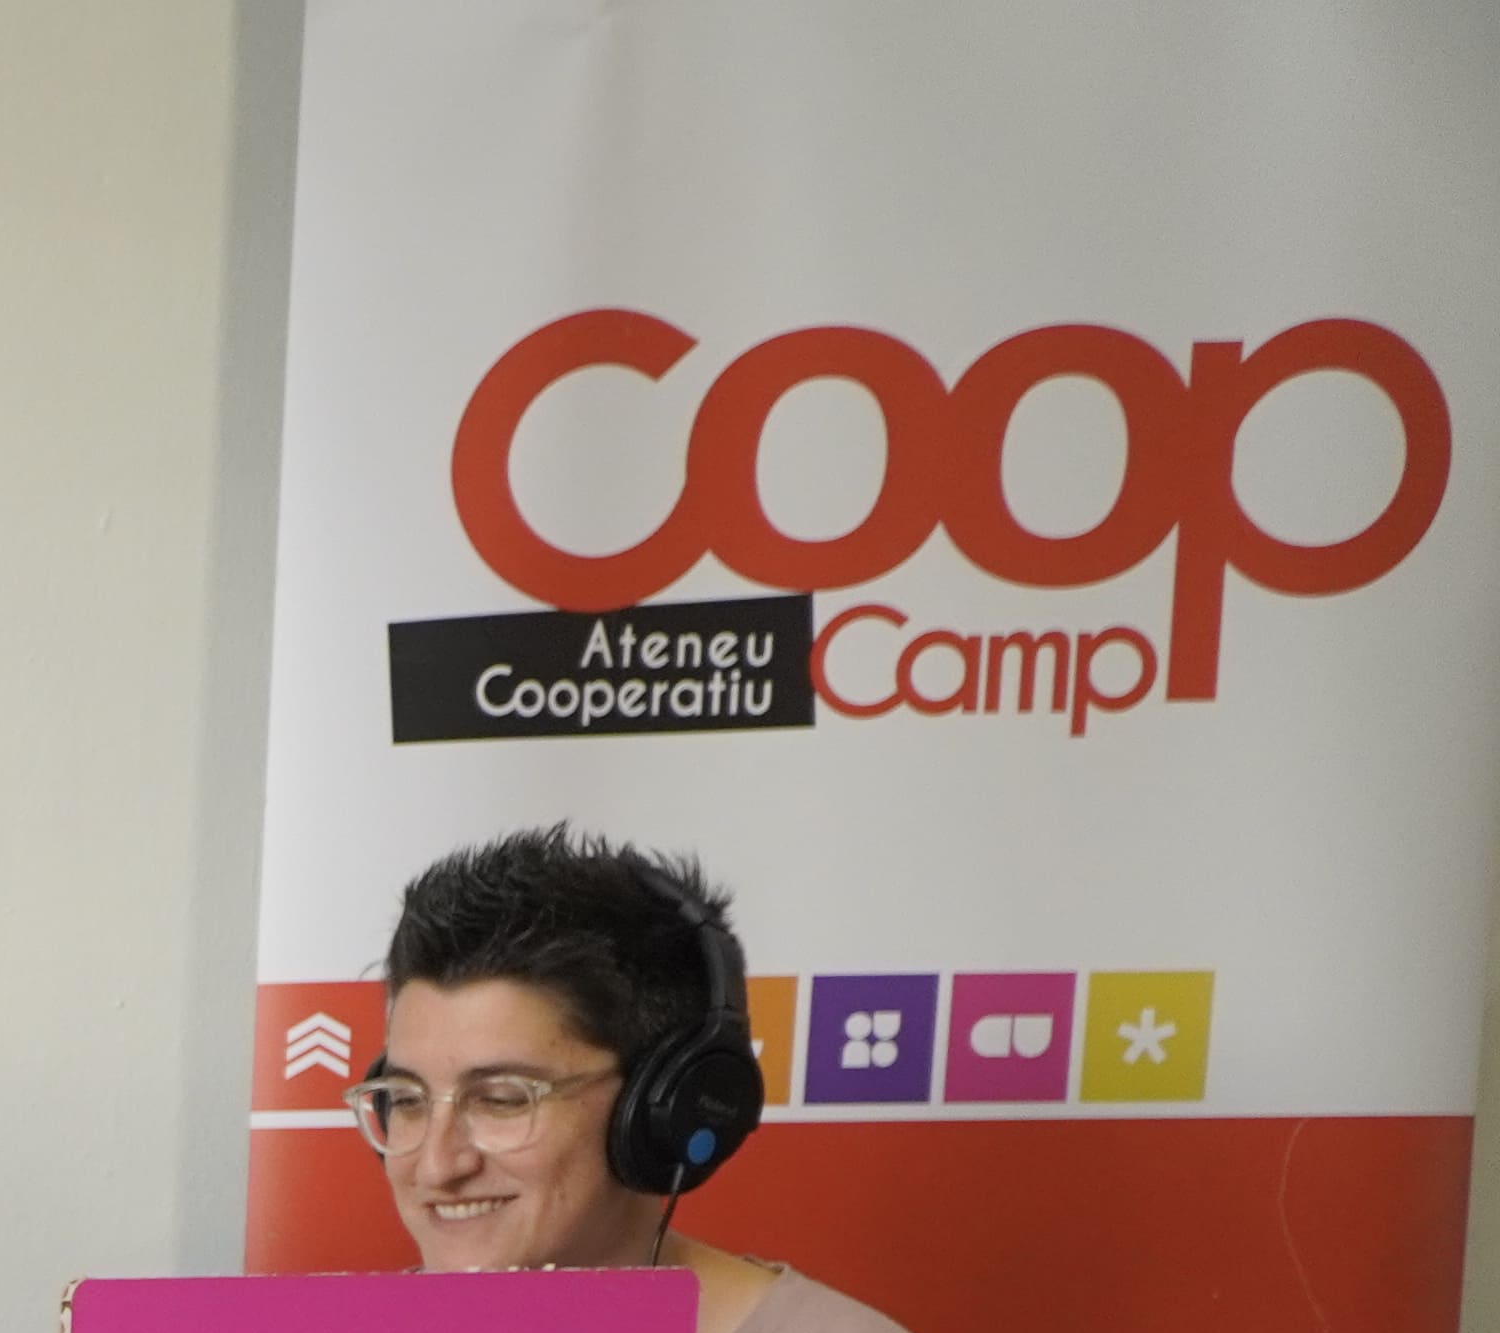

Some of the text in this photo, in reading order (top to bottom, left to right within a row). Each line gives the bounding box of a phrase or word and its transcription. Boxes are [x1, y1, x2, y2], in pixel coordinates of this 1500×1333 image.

[581, 621, 776, 670] Ateneu
[809, 604, 1158, 738] Camp
[475, 664, 776, 727] Cooperatiu
